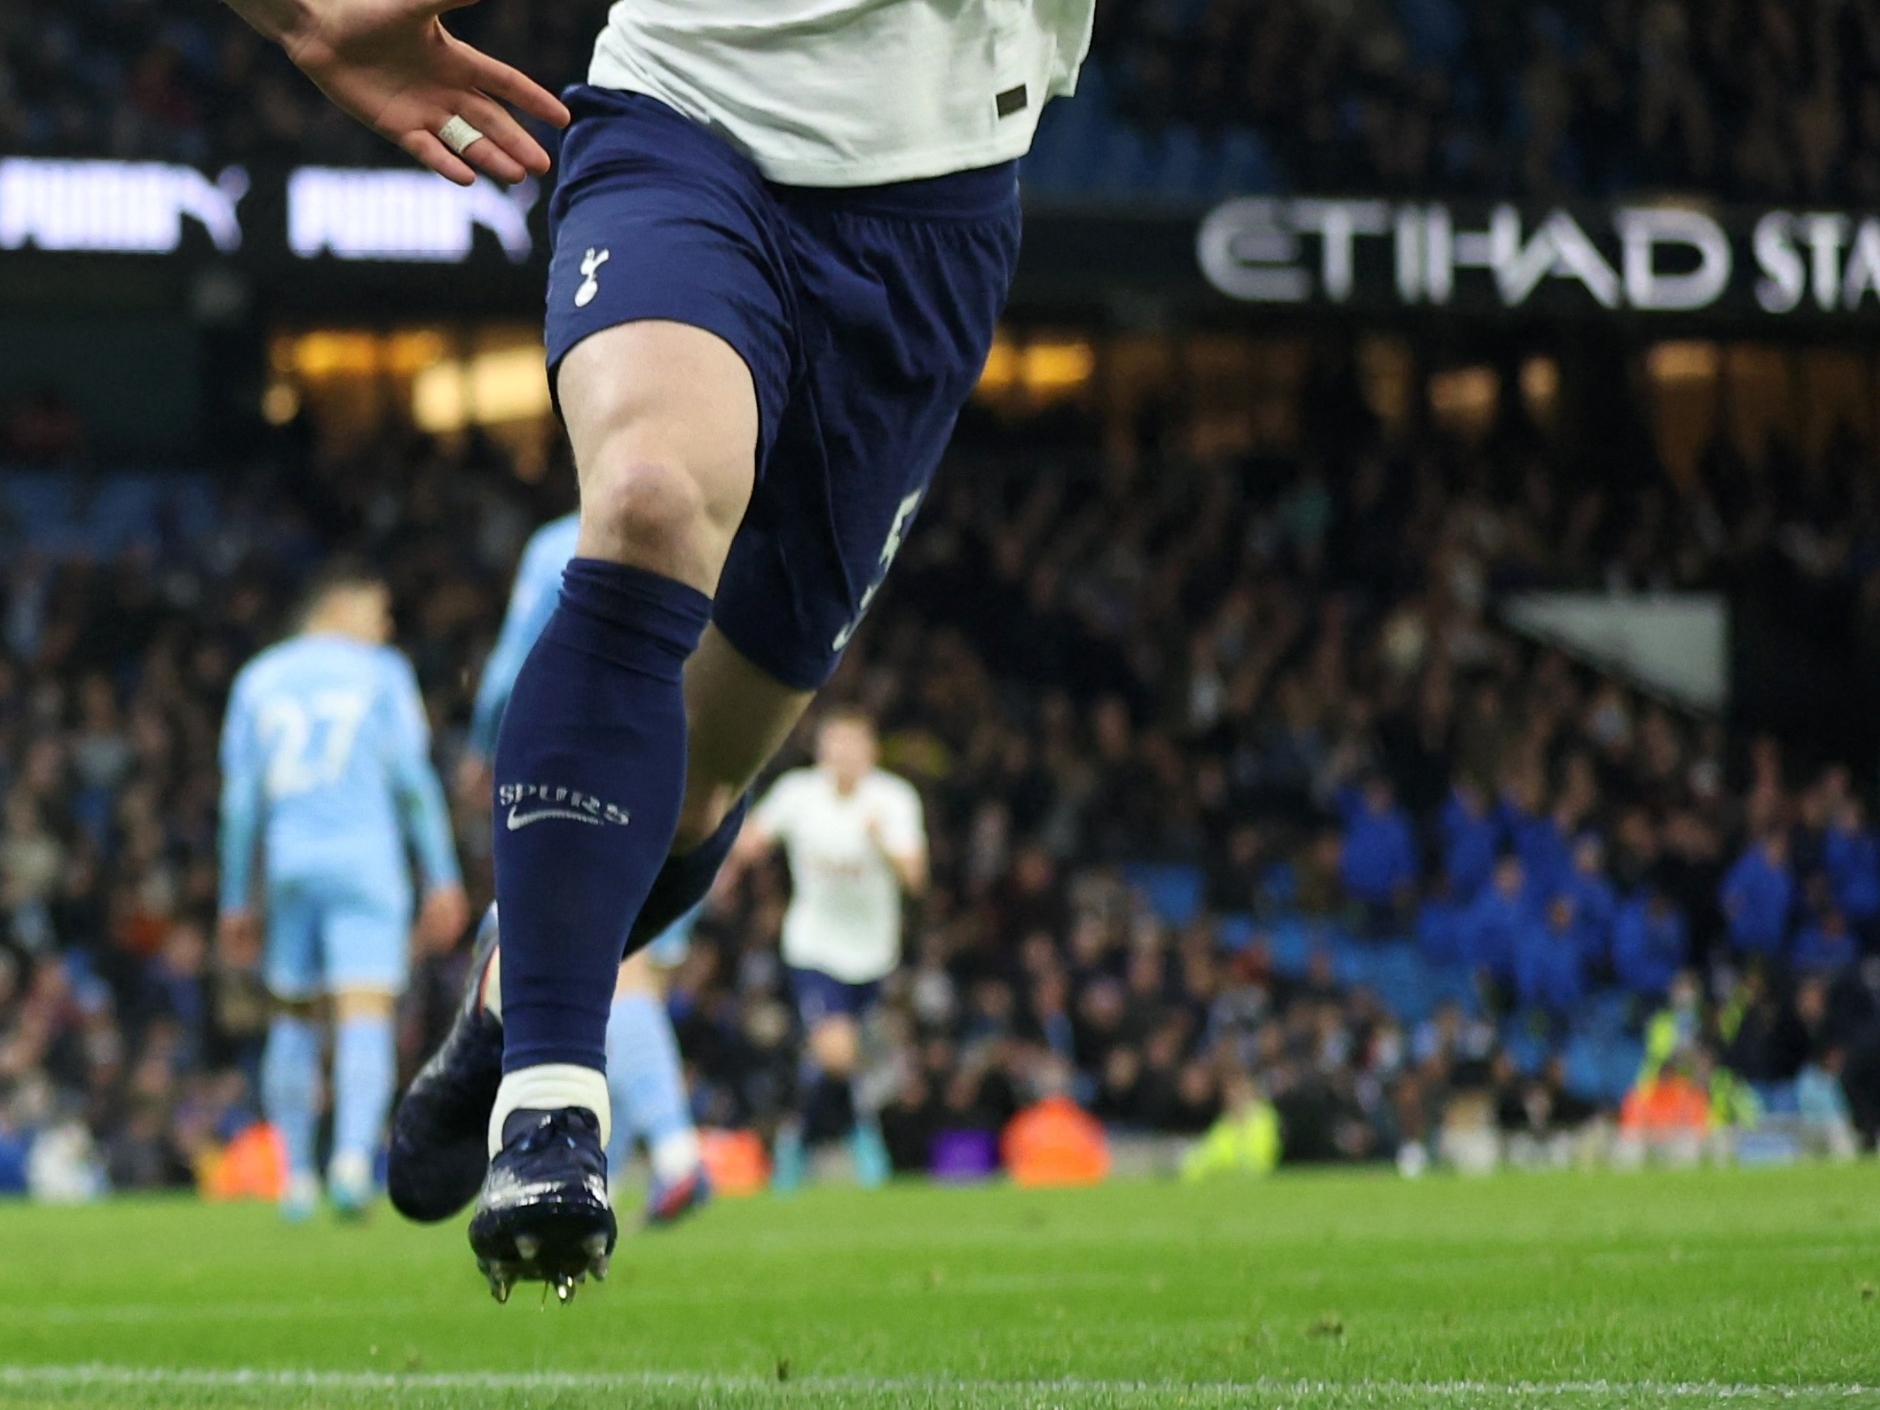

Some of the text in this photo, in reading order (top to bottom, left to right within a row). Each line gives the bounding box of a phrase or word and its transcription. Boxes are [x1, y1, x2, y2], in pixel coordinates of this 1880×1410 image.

[1198, 194, 1732, 312] ETIHAD
[257, 689, 374, 801] 27
[499, 783, 631, 826] SPURS
